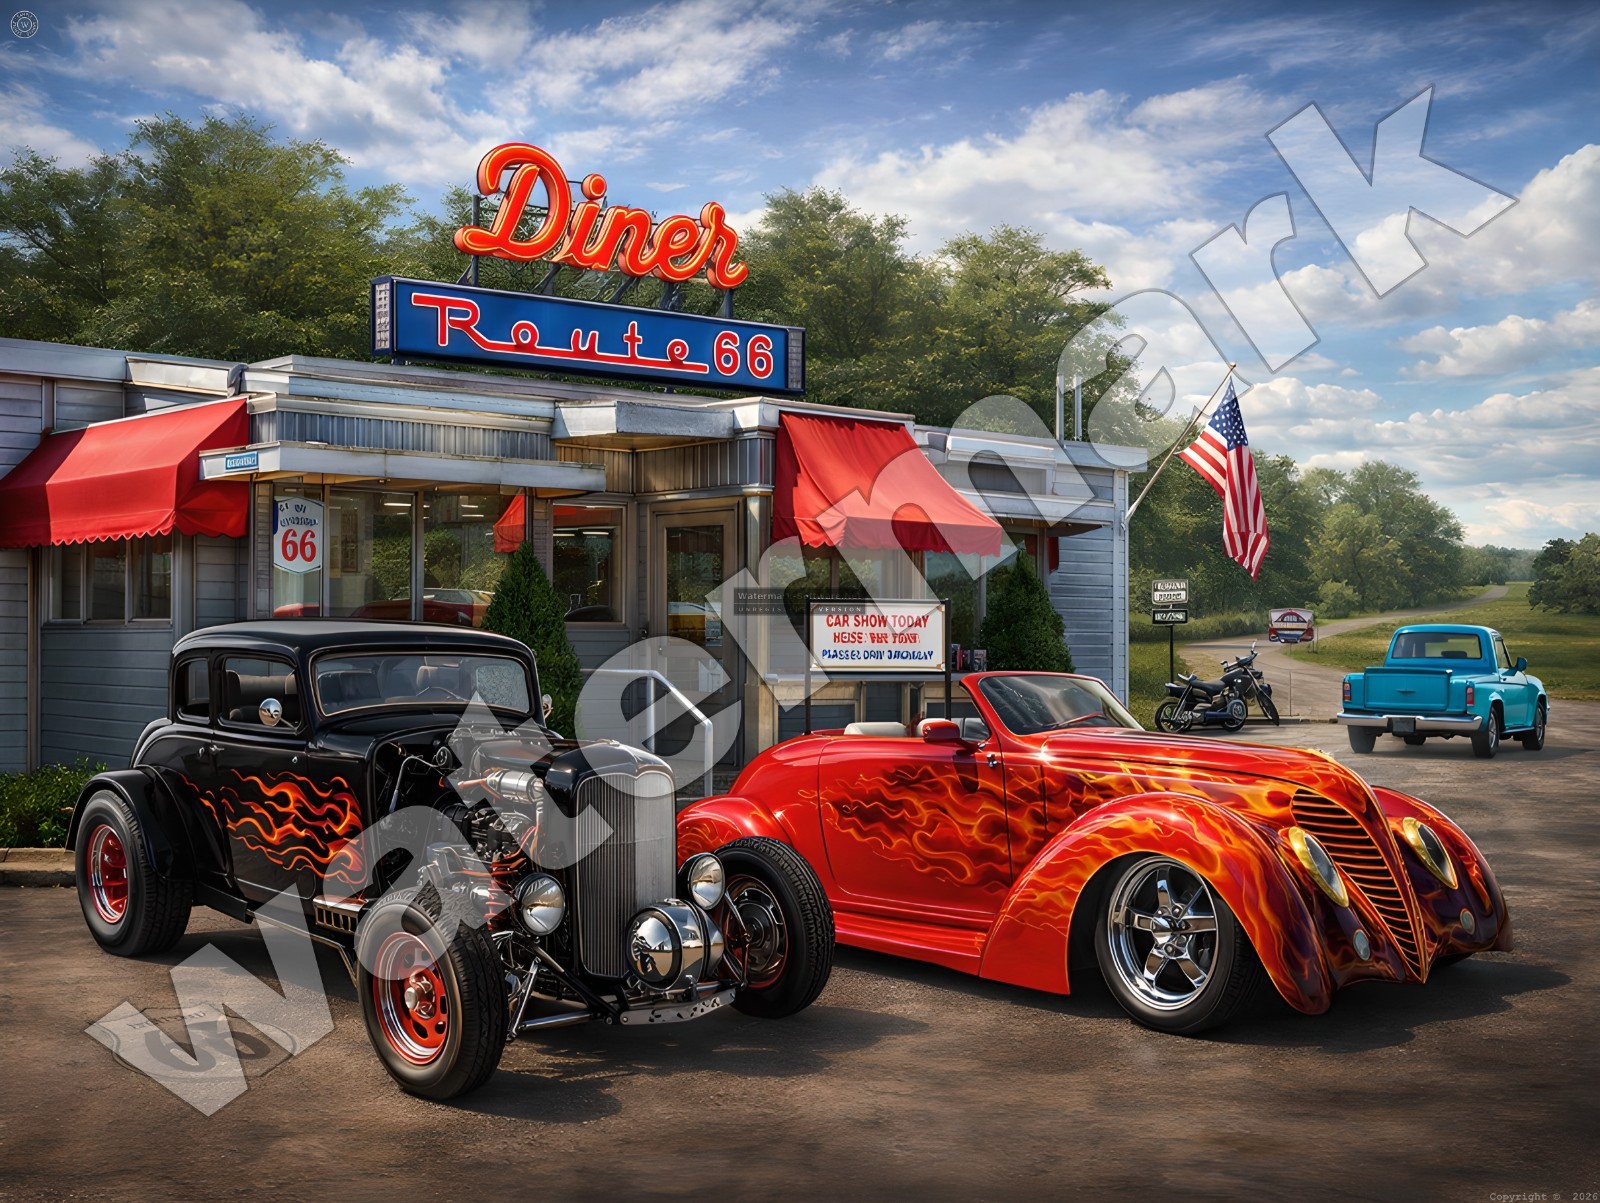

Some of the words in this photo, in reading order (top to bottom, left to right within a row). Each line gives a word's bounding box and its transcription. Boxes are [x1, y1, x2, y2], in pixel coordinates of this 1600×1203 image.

[453, 142, 749, 290] Diner
[411, 291, 709, 374] Route
[713, 331, 774, 379] 66
[281, 528, 317, 562] 66
[825, 614, 850, 628] CAR
[853, 614, 889, 628] SHOW
[891, 614, 930, 628] TODAY
